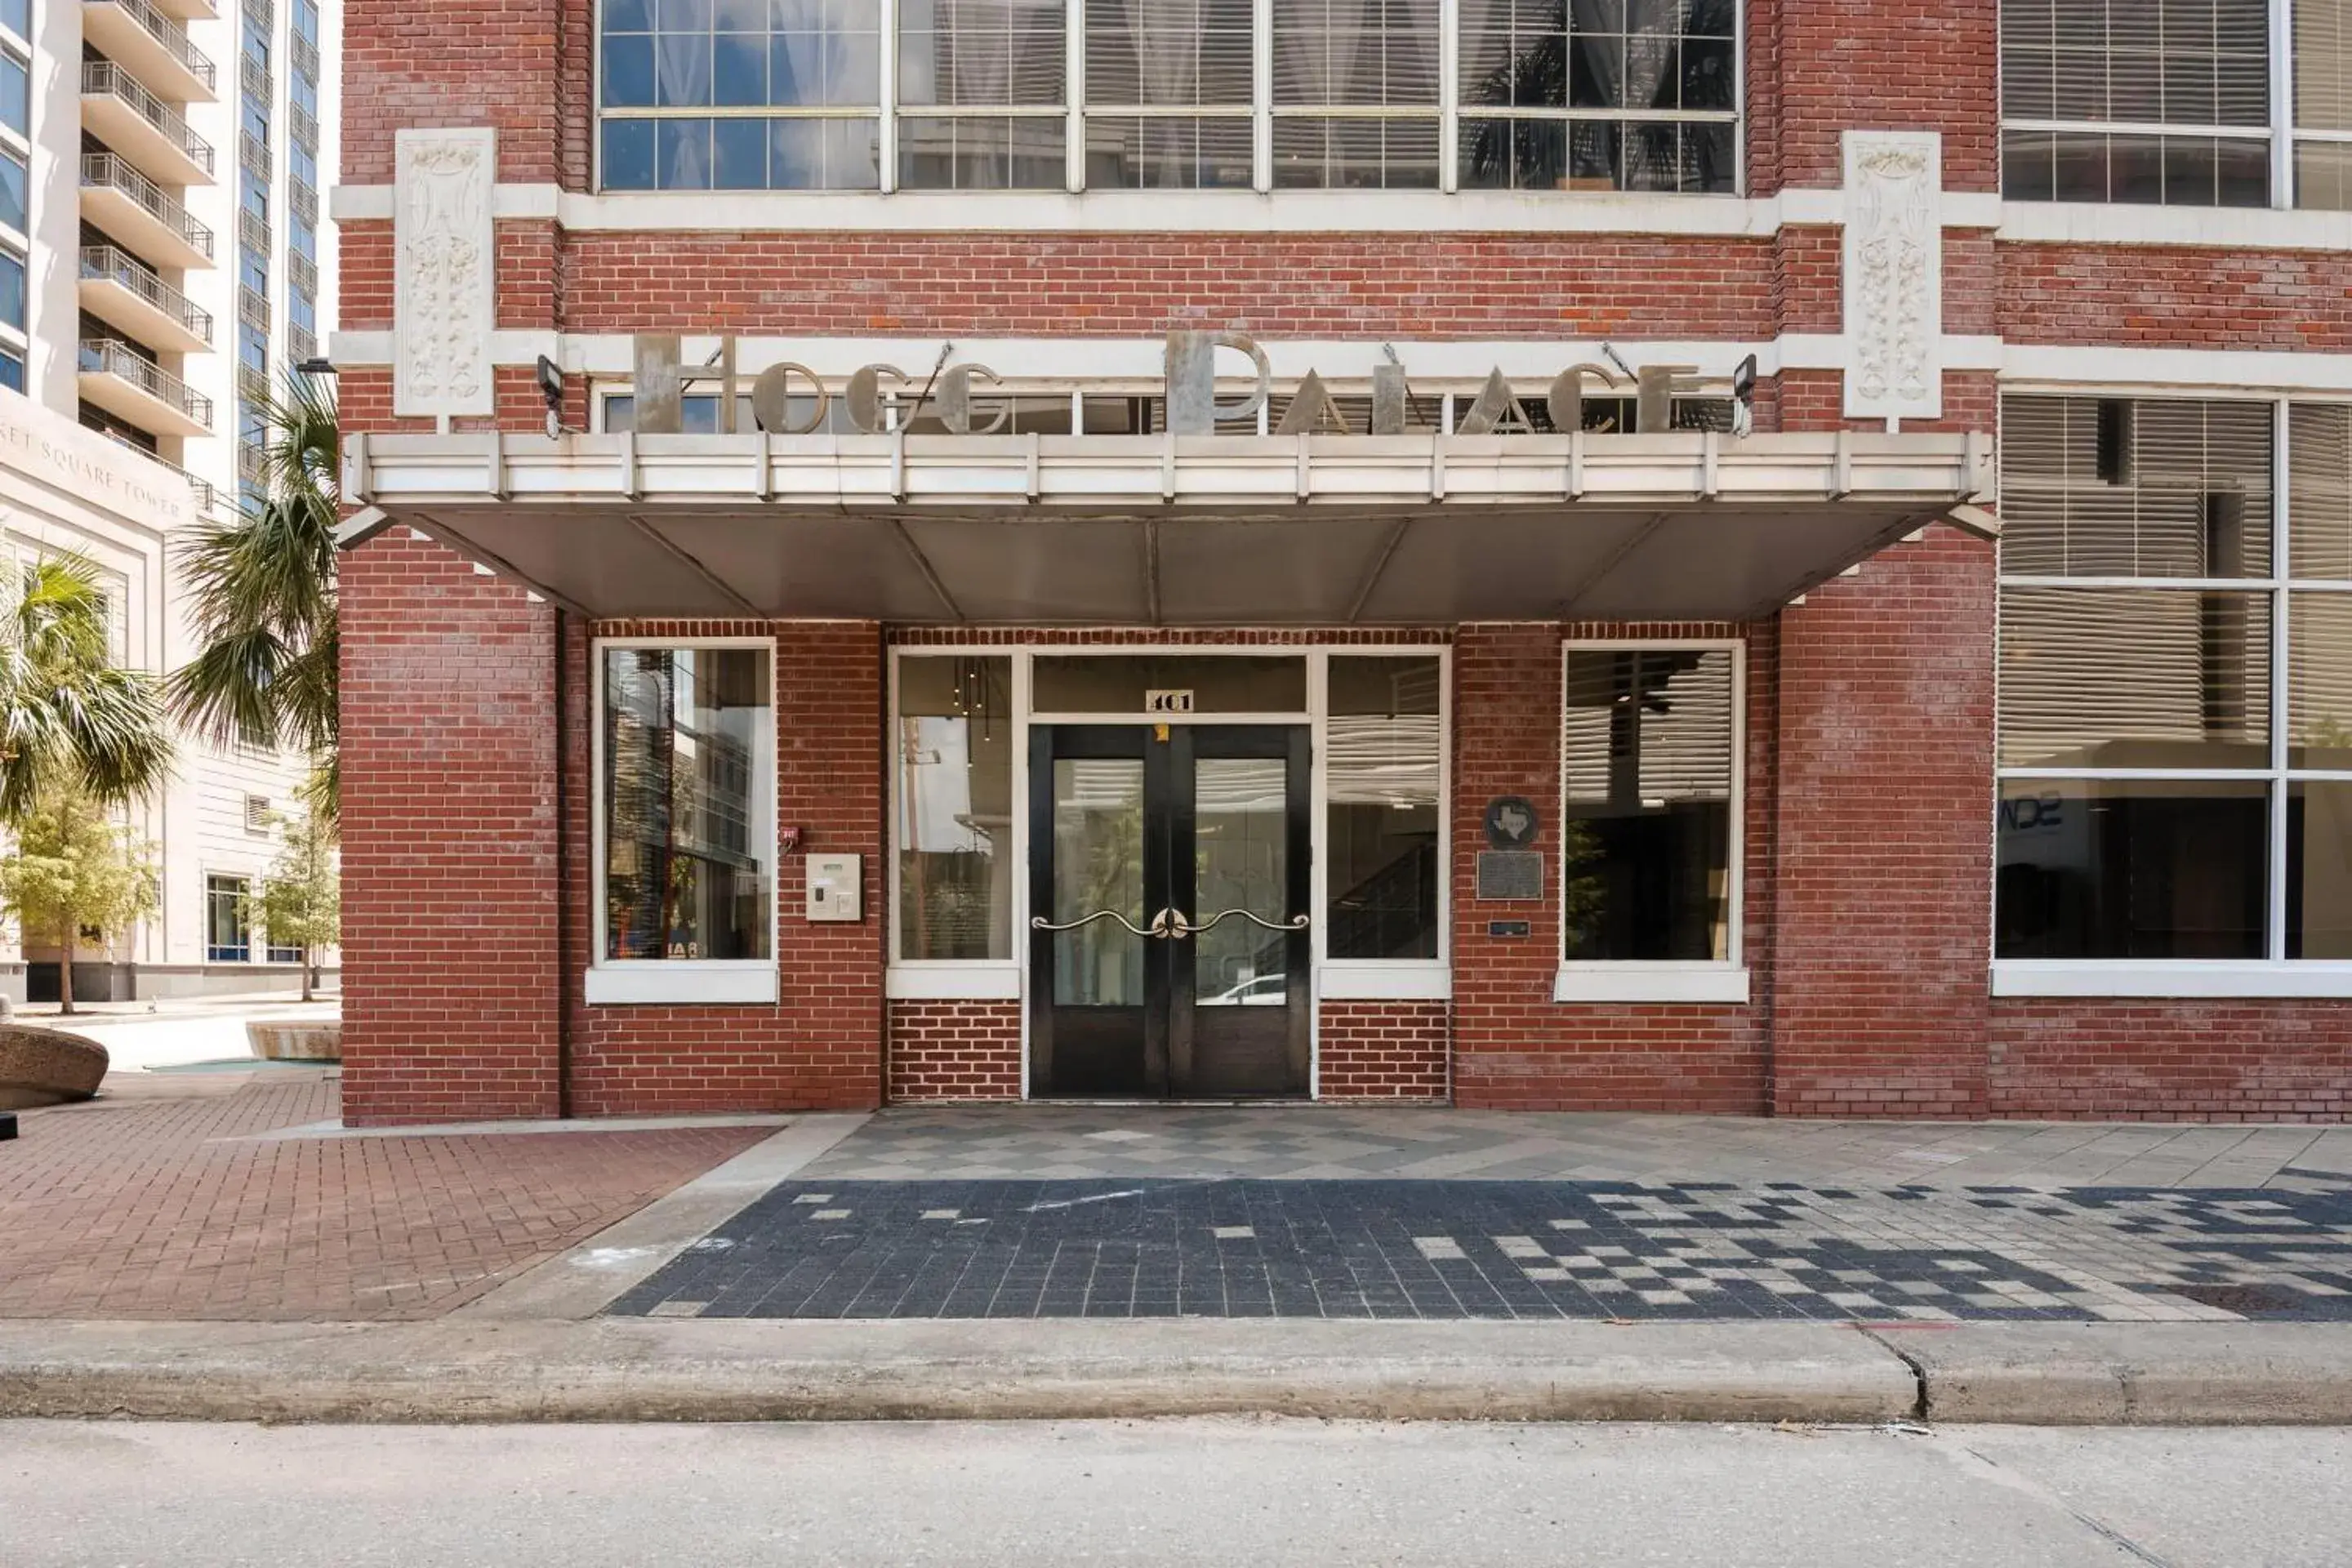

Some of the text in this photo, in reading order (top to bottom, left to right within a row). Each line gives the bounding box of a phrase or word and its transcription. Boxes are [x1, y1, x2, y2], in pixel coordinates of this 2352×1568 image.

[634, 331, 1701, 434] HOGG PALACE
[41, 439, 114, 488] SQUARE
[124, 479, 180, 519] TOWER
[1150, 694, 1190, 711] 401
